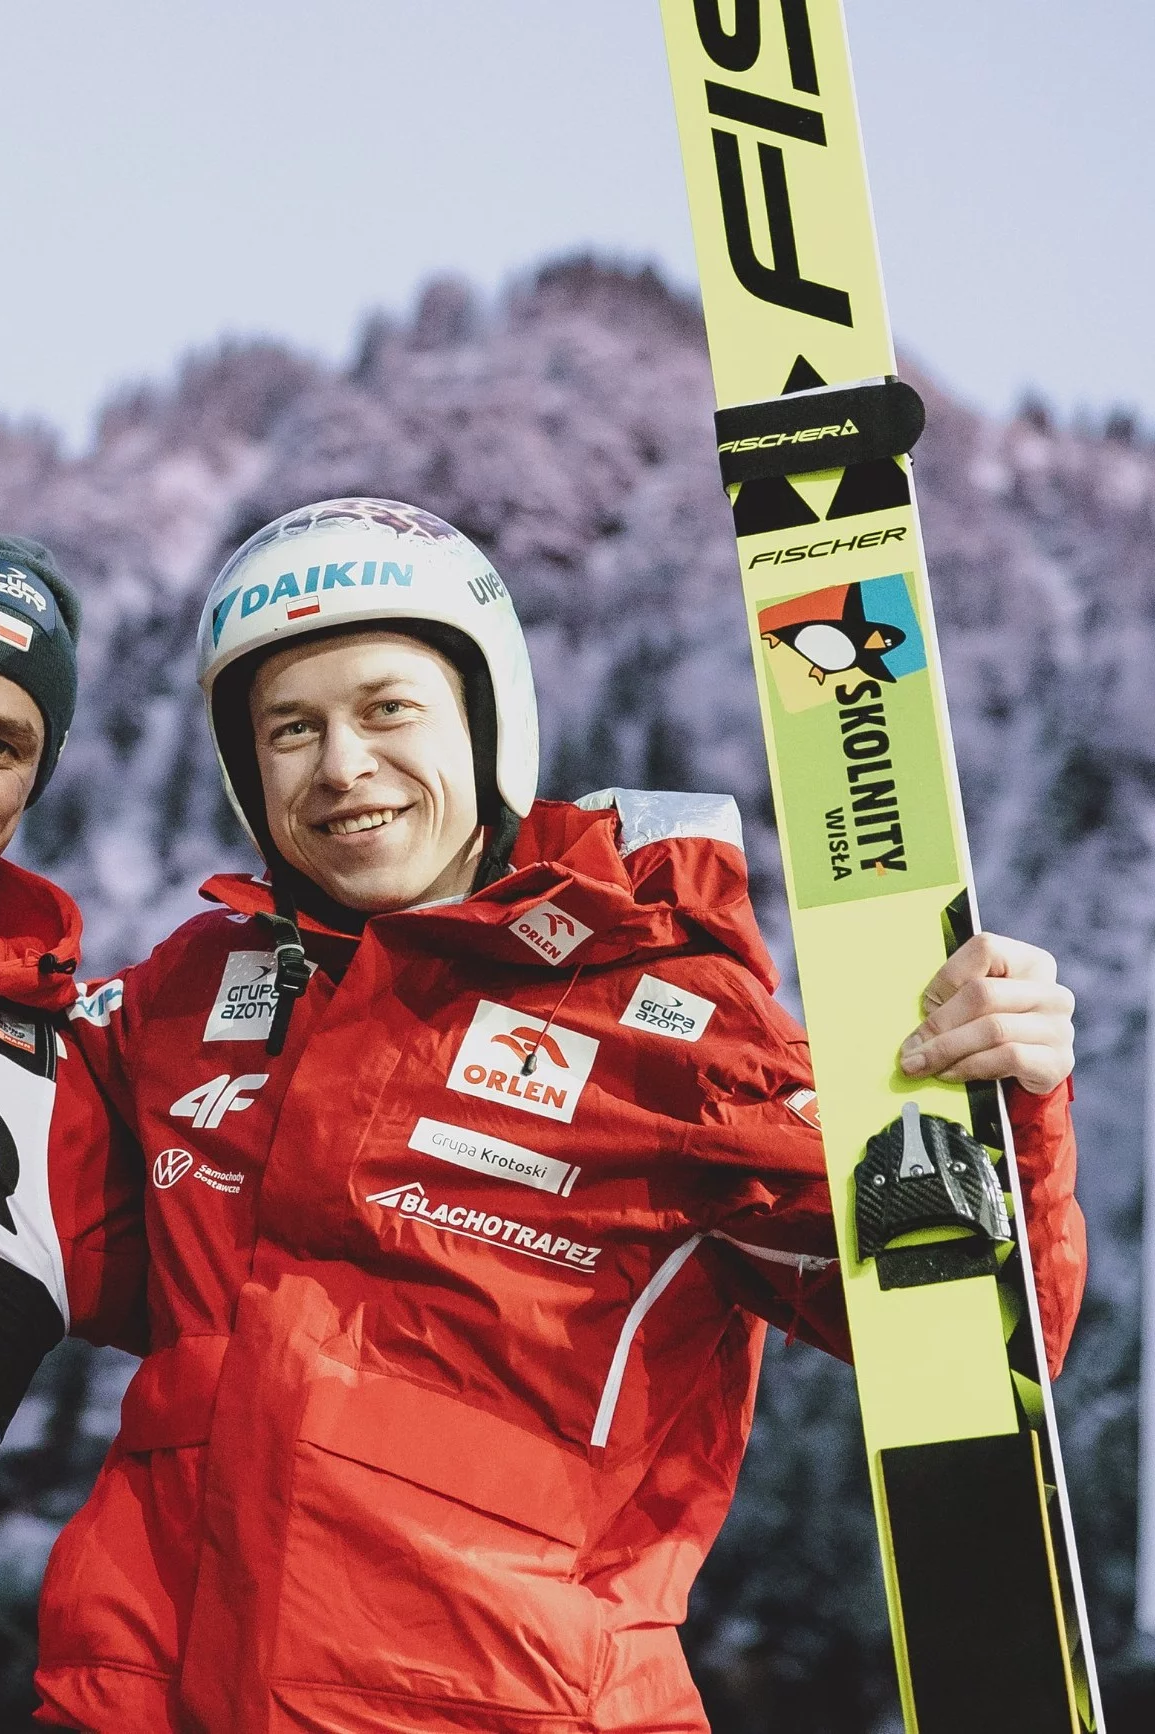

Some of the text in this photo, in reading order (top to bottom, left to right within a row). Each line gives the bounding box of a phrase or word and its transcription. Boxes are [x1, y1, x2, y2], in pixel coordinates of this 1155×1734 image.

[718, 425, 842, 454] FISCHER
[748, 526, 908, 570] FISCHER
[240, 560, 414, 620] DAIKIN
[467, 572, 507, 606] uve
[835, 680, 908, 874] SKOLNITY
[518, 923, 562, 960] ORLEN
[169, 1074, 270, 1129] 4F
[463, 1063, 568, 1110] ORLEN
[199, 1164, 245, 1184] Samochody
[431, 1132, 548, 1180] Grupa Krotoski
[193, 1171, 241, 1194] Dostawcze
[400, 1192, 602, 1267] BLACHOTRAPEZ
